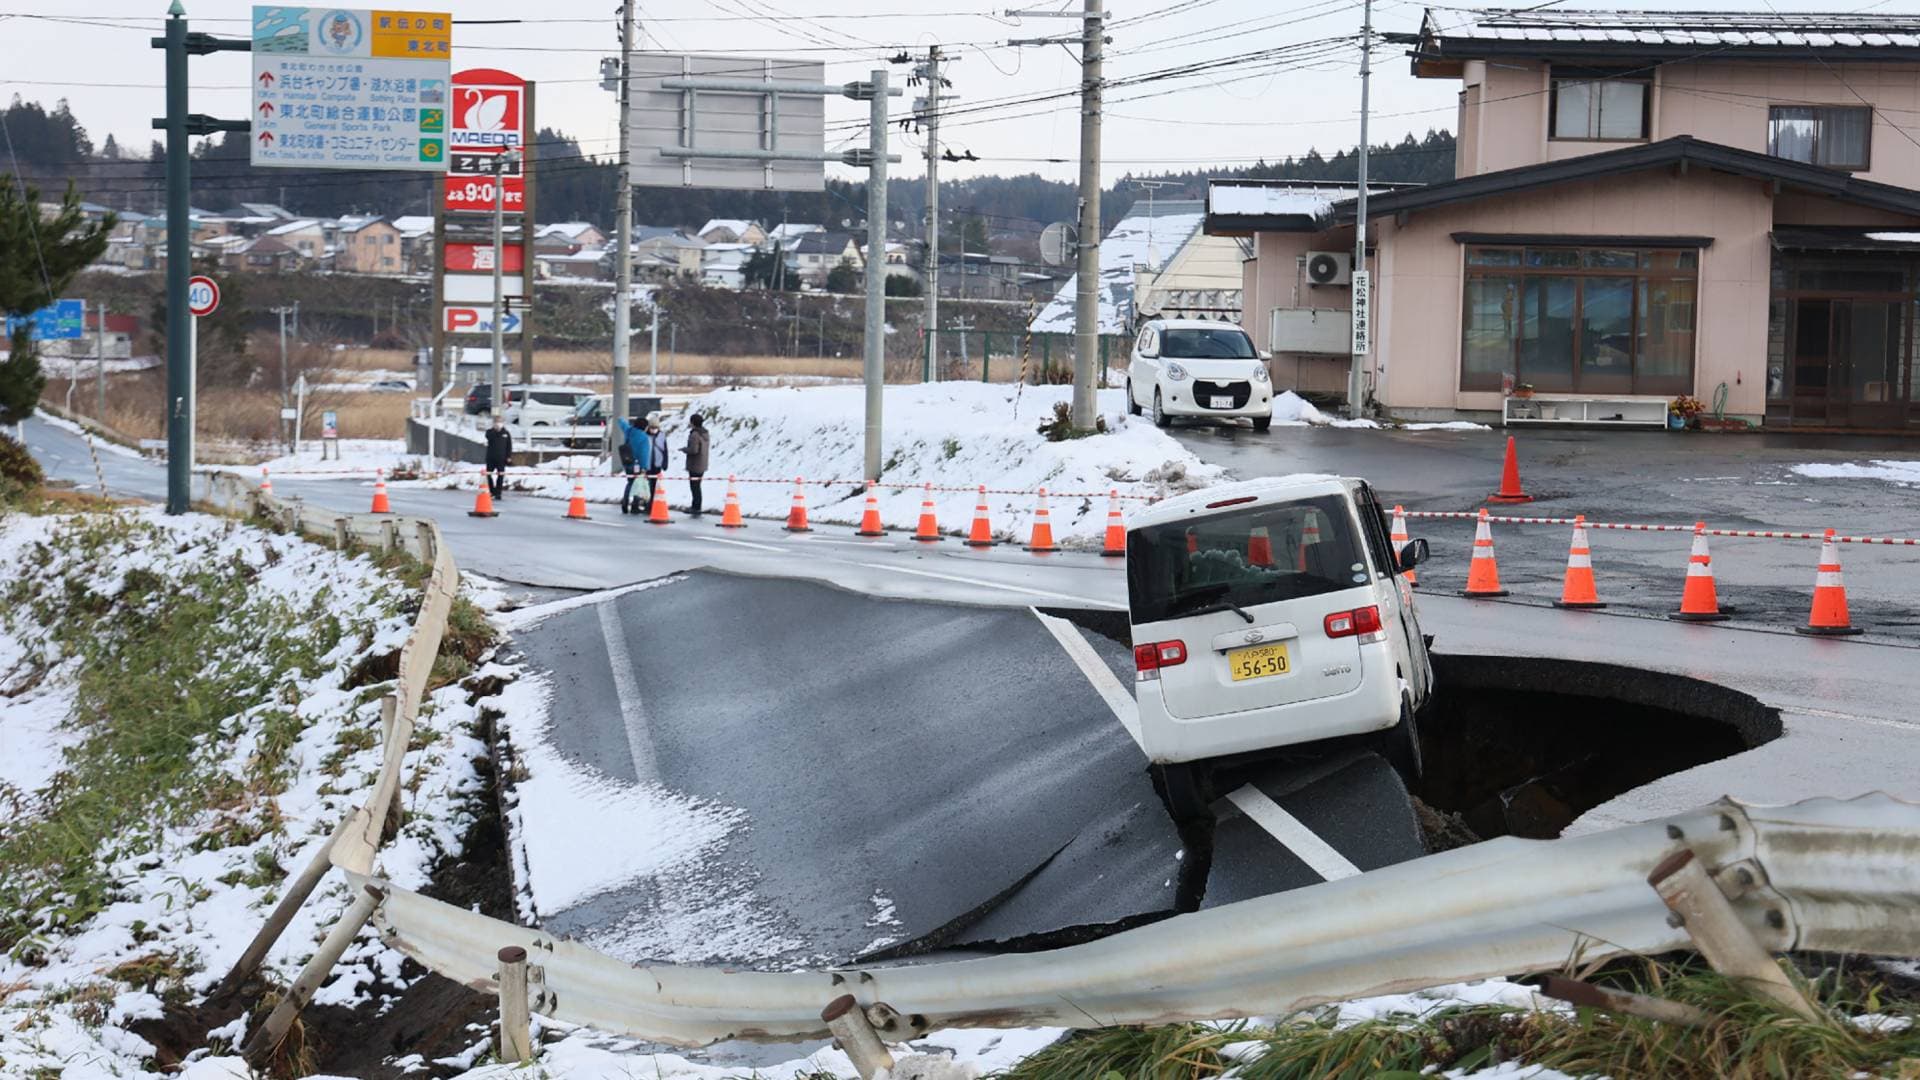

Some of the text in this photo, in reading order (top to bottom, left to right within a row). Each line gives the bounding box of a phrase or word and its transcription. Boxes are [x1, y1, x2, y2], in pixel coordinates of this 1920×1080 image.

[279, 104, 416, 122] 東北町総合運動公園
[303, 121, 336, 131] General
[341, 122, 368, 133] Sports
[372, 123, 392, 132] Park
[451, 132, 519, 145] MAEDA
[333, 152, 380, 162] Community
[189, 287, 211, 305] 40
[447, 308, 478, 331] P
[1242, 655, 1286, 677] 56-50
